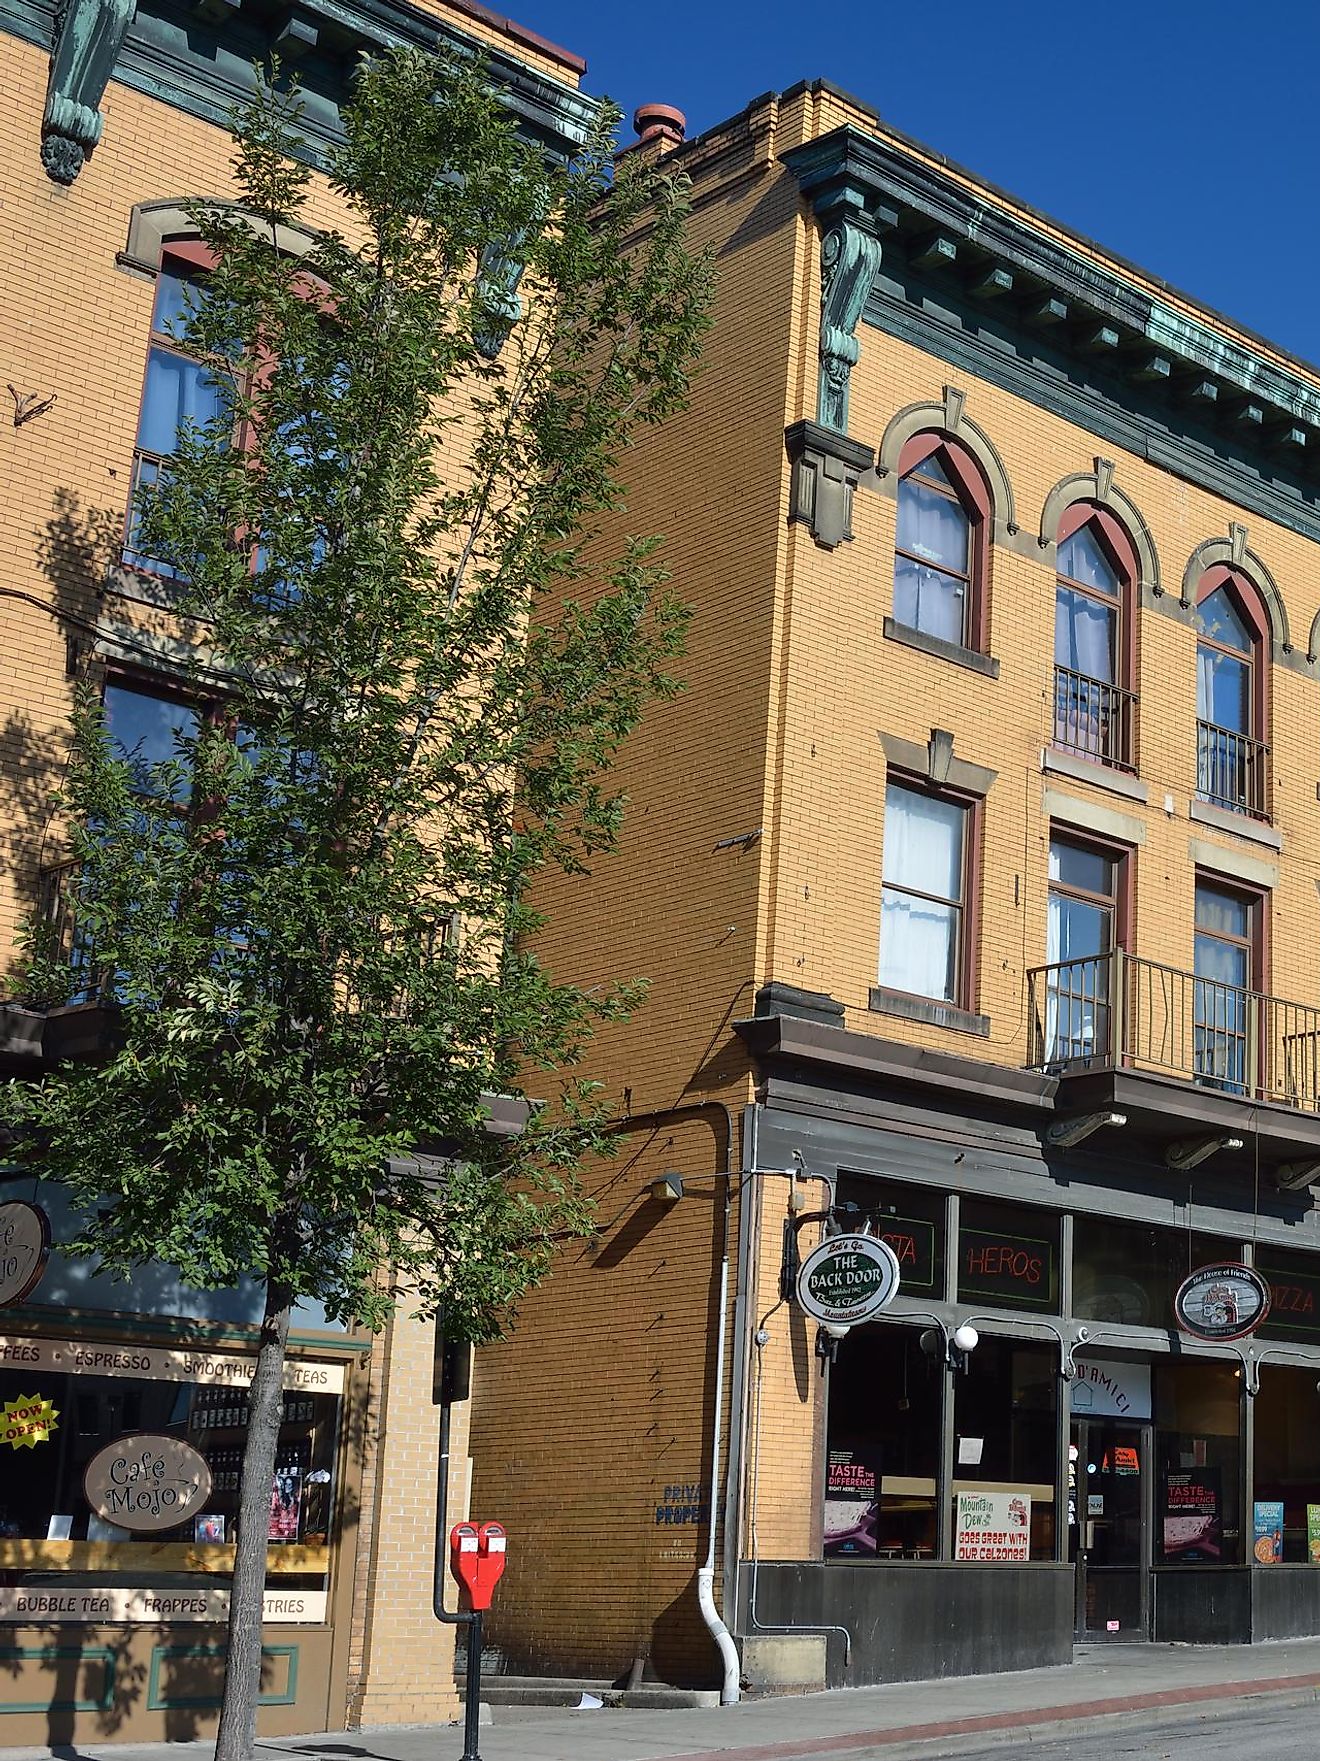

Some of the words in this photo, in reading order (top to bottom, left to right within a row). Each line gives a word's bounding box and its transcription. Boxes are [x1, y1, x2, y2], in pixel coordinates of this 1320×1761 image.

[833, 1254, 858, 1270] THE
[968, 1246, 1042, 1284] HEROS
[810, 1272, 843, 1289] BACK
[845, 1268, 881, 1285] DOOR
[1230, 1269, 1252, 1281] Friends
[834, 1298, 841, 1307] &
[75, 1350, 151, 1371] ESPRESSO
[183, 1360, 256, 1380] SMOOTHIE
[294, 1369, 328, 1385] TEAS
[7, 1403, 43, 1423] NOW
[5, 1418, 51, 1440] OPEN!
[110, 1451, 166, 1485] Café
[829, 1464, 865, 1478] TASTE
[828, 1476, 876, 1487] DIFFERENCE
[105, 1481, 177, 1516] Mojo
[664, 1484, 703, 1504] PRIVA
[1168, 1486, 1204, 1496] TASTE
[960, 1496, 994, 1512] Mountain
[1168, 1496, 1216, 1504] DIFFERENCE
[961, 1513, 983, 1530] Dew
[959, 1546, 978, 1560] OUR
[16, 1597, 76, 1612] BUBBLE
[81, 1597, 110, 1612] TEA
[144, 1598, 207, 1613] FRAPPES
